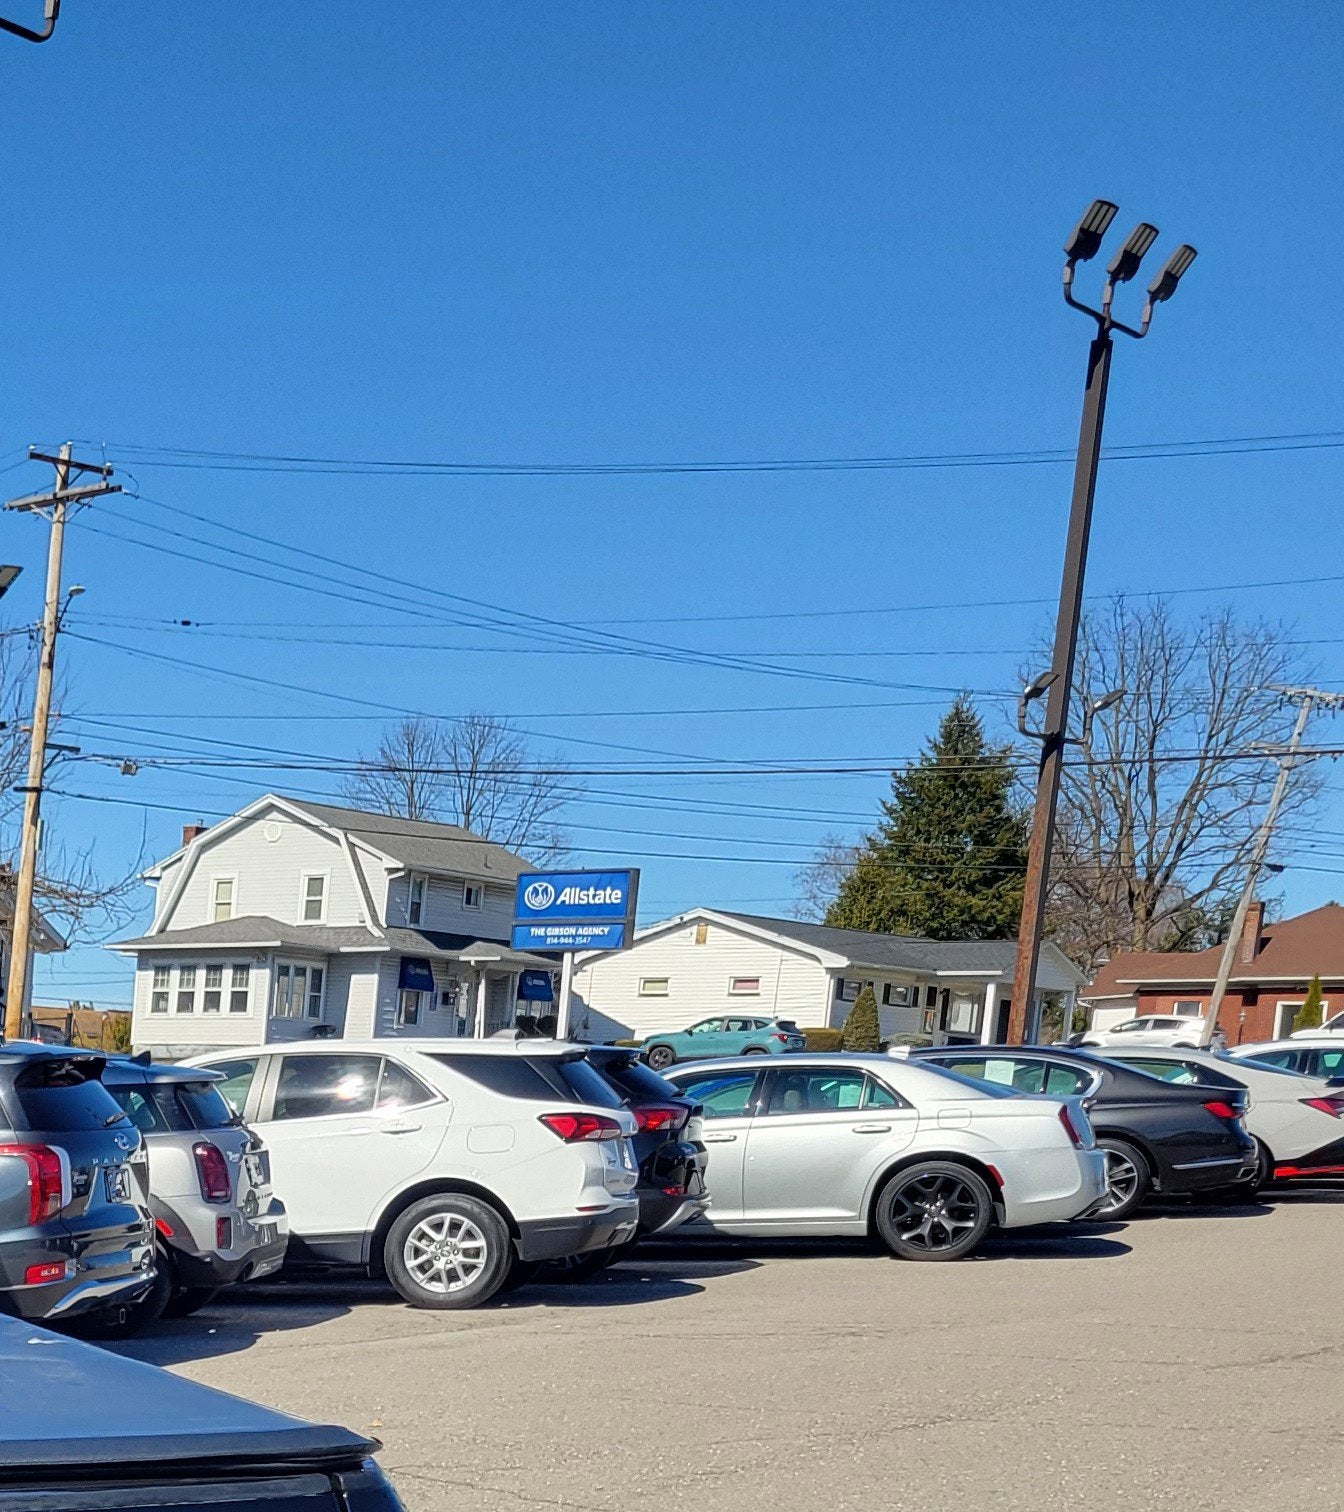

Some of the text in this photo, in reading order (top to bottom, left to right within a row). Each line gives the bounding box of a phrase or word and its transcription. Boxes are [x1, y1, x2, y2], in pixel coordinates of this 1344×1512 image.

[555, 886, 622, 905] Allstate
[530, 926, 609, 936] THE GIBSON AGENCY
